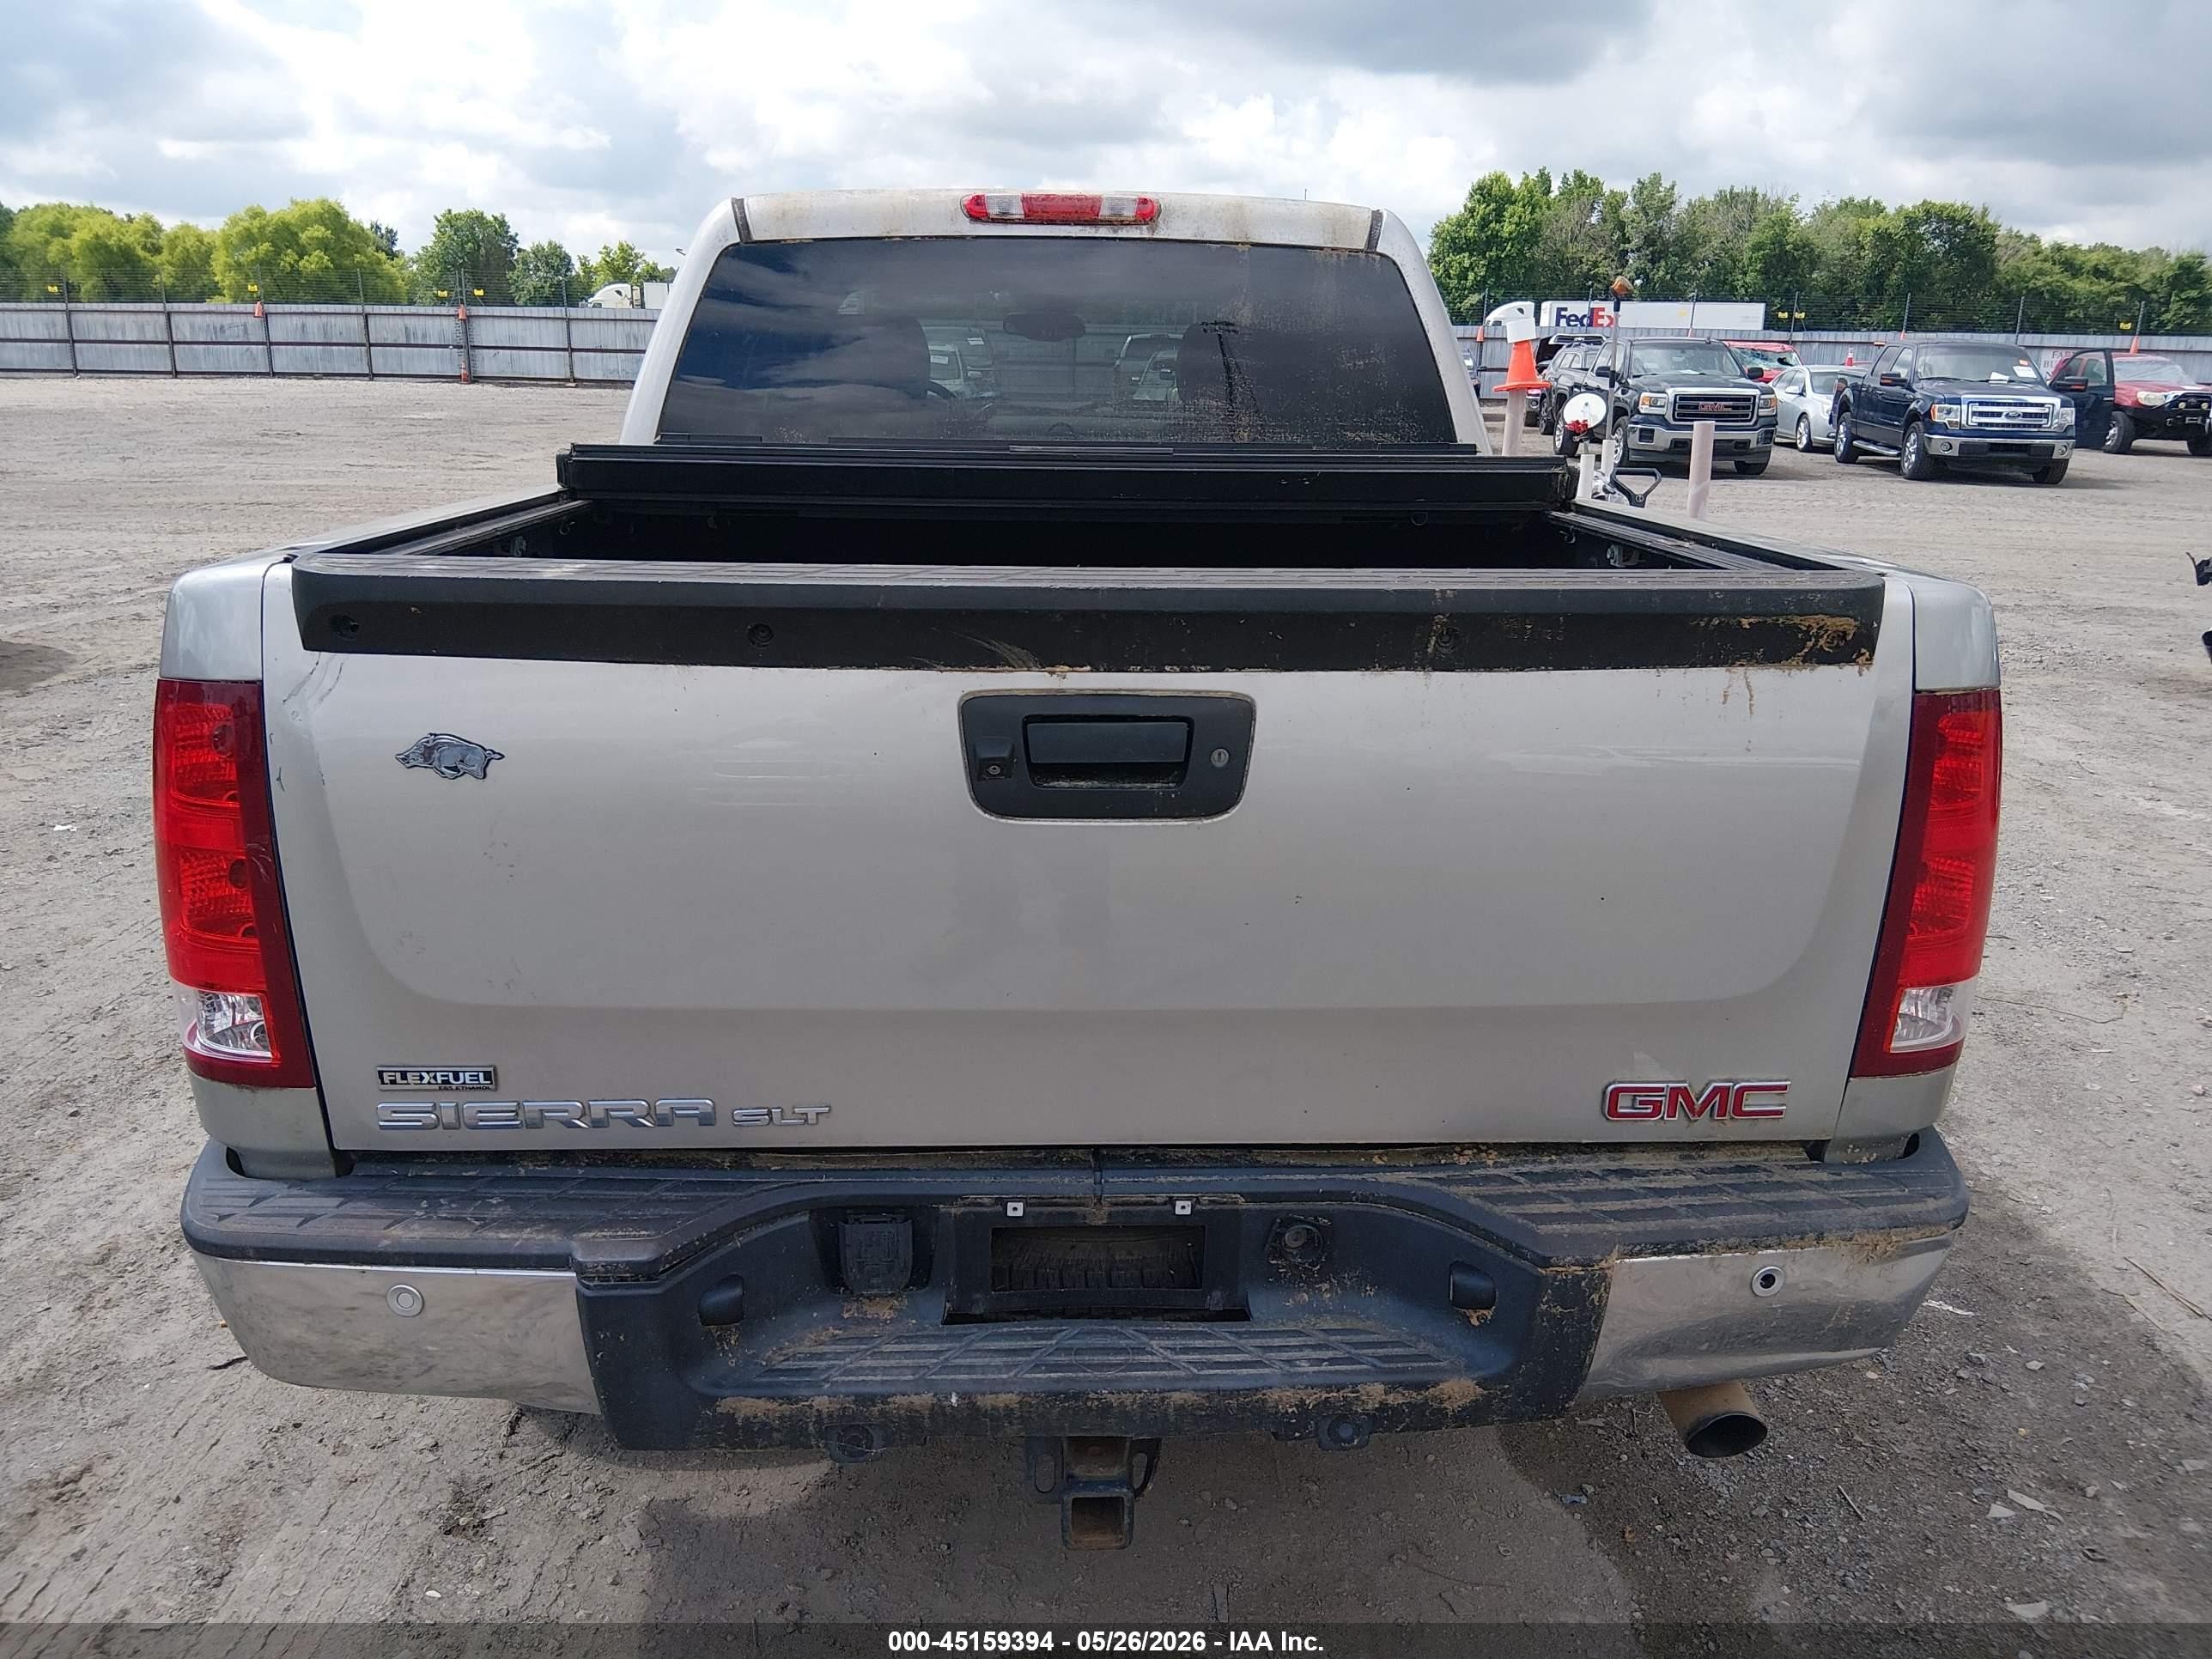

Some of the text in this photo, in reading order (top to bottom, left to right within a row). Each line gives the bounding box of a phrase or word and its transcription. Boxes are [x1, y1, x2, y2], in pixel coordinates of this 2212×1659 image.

[1555, 307, 1621, 327] FedEx
[382, 1072, 491, 1085] FLEXFUEL
[376, 1098, 831, 1130] SIERRA SLT
[1605, 1081, 1791, 1121] GMC
